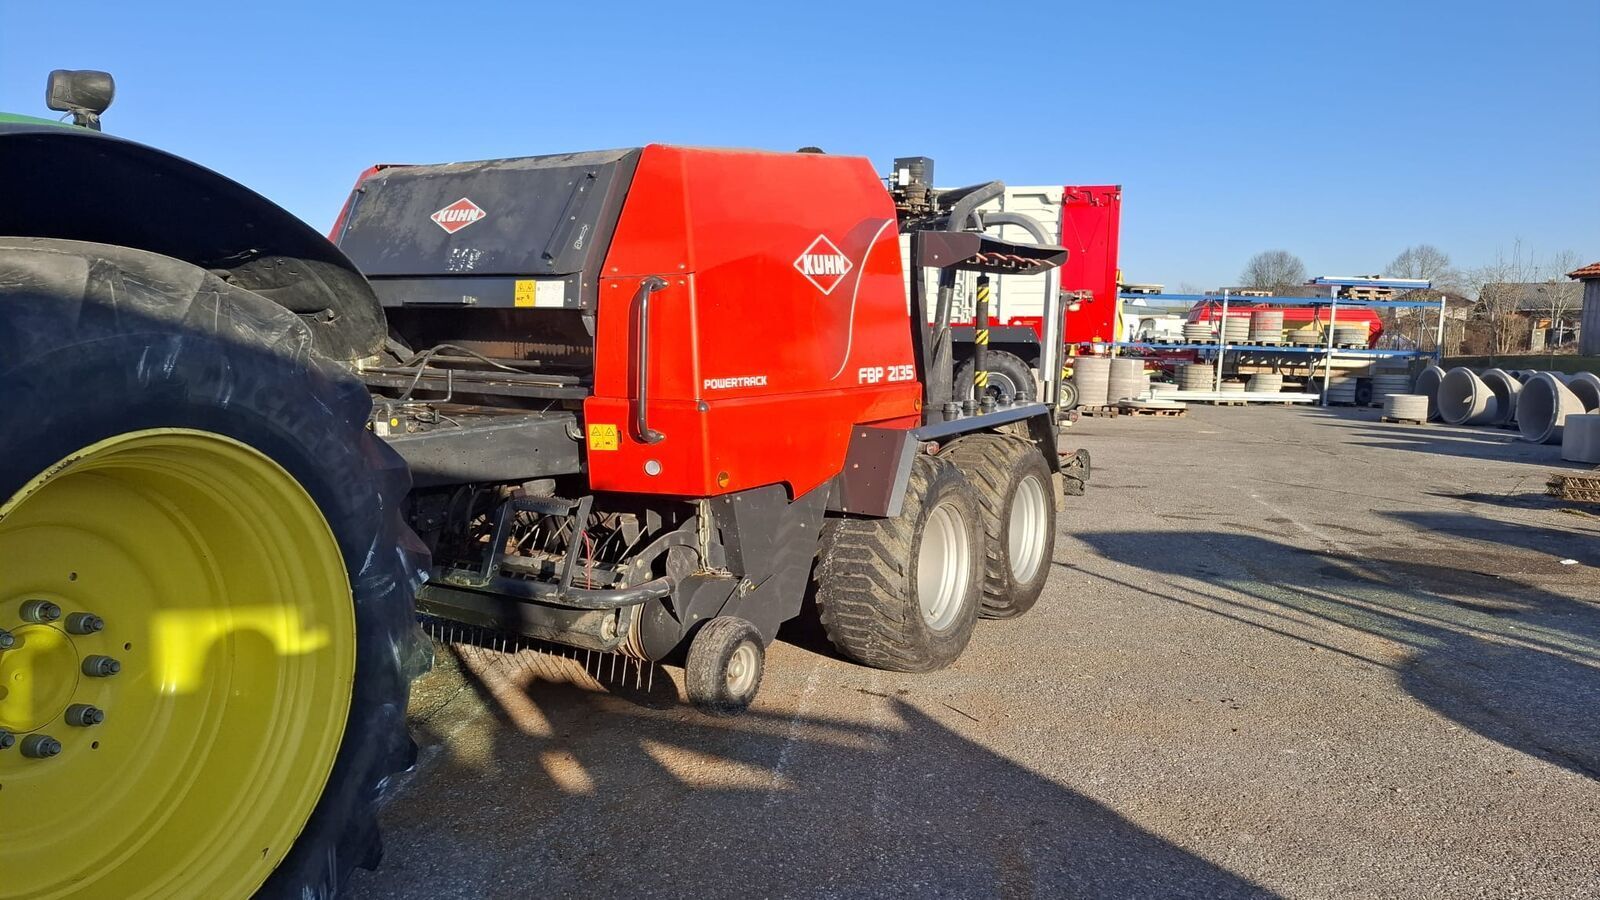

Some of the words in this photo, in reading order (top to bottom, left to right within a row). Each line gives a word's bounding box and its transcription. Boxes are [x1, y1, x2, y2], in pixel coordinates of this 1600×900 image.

[437, 208, 480, 222] KUHN
[803, 254, 845, 275] KUHN
[858, 367, 883, 384] FBP
[887, 365, 914, 381] 2135
[704, 376, 768, 390] POWERTRACK
